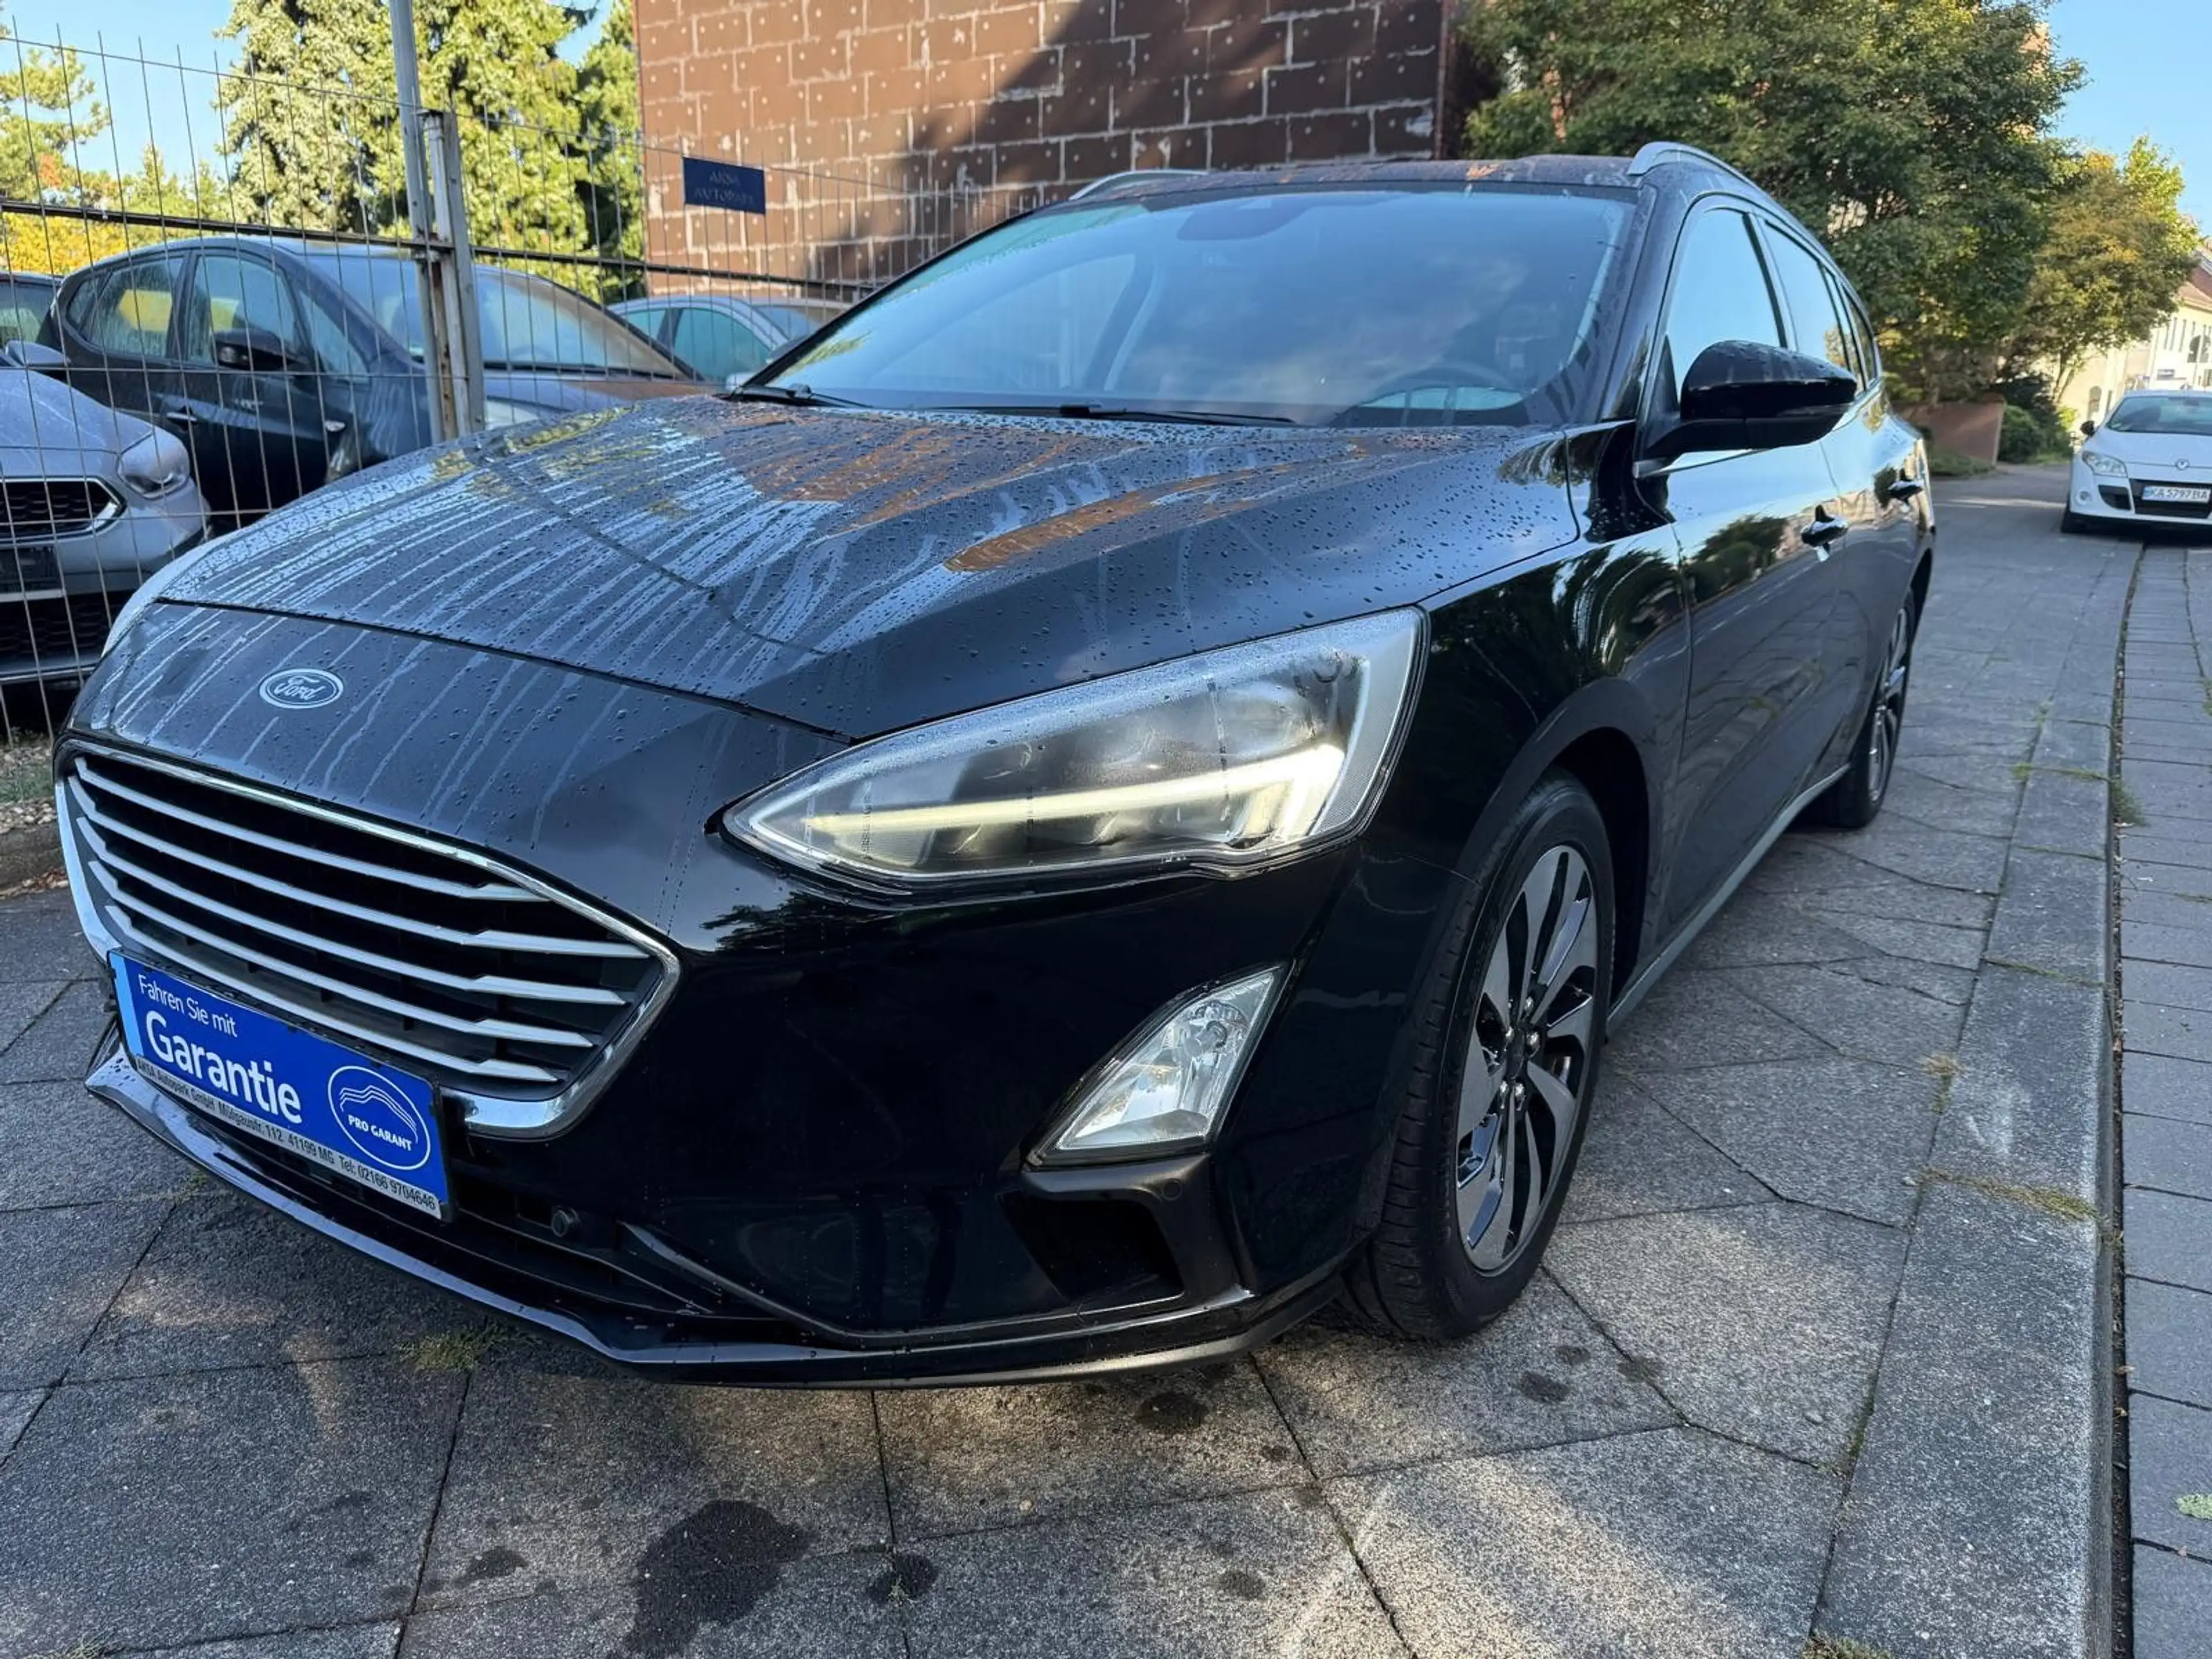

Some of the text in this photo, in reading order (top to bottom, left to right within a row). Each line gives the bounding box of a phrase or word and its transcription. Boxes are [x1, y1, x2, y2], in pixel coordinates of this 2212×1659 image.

[274, 676, 327, 700] Ford
[138, 974, 237, 1037] Fahren Sie mit
[146, 1010, 302, 1124] Garantie
[266, 1125, 285, 1143] 112
[317, 1145, 335, 1164] MG
[348, 1114, 412, 1152] PRO GARANT
